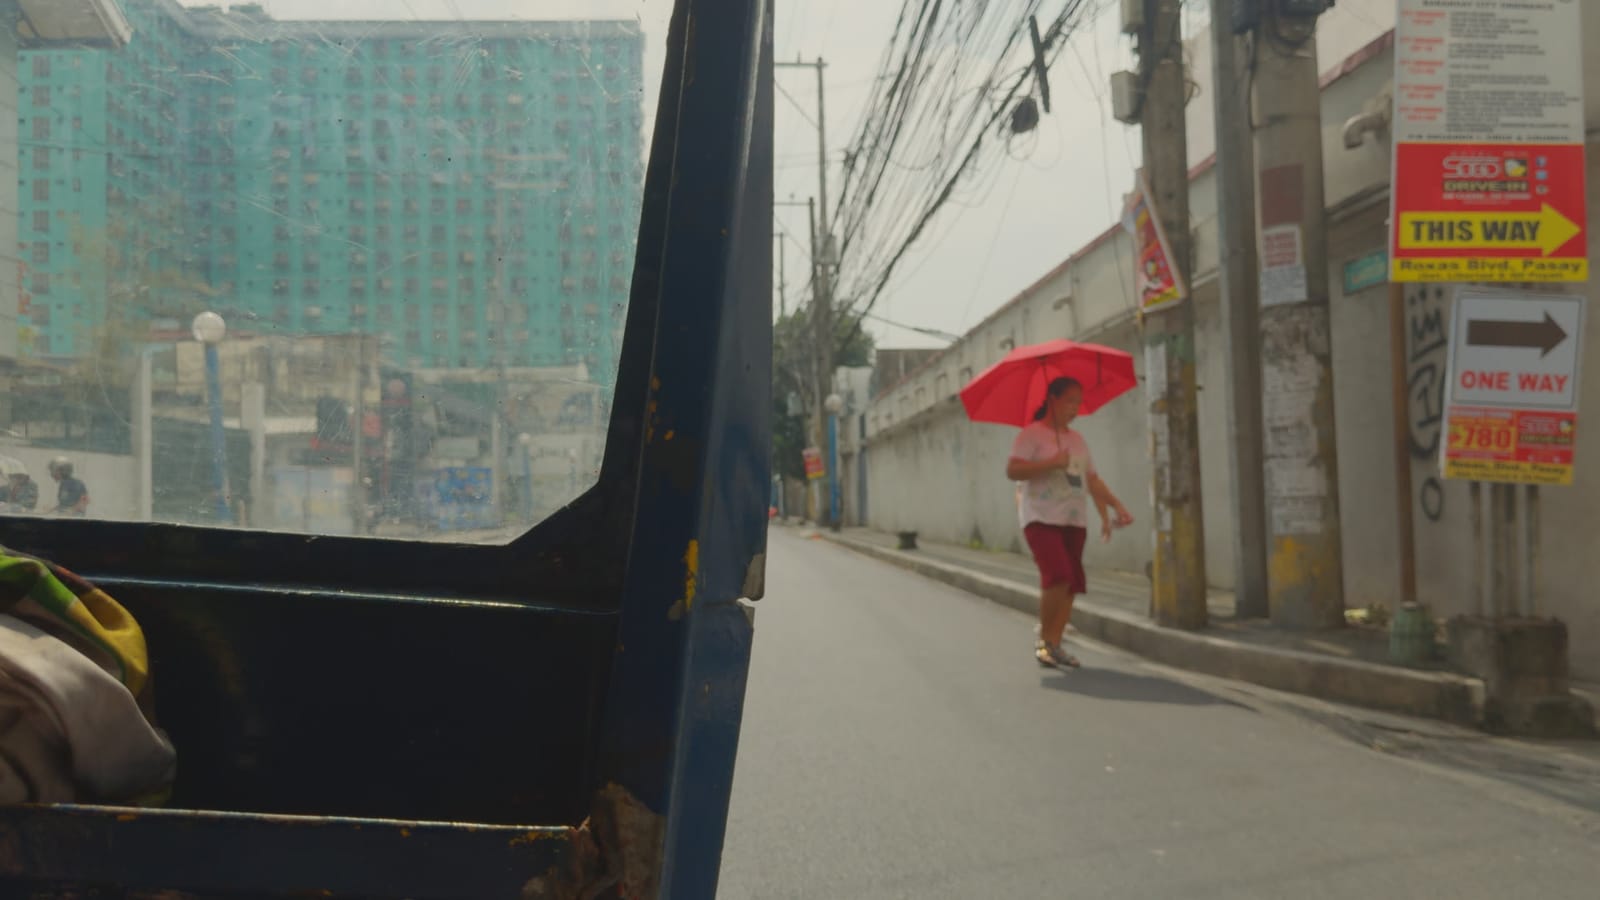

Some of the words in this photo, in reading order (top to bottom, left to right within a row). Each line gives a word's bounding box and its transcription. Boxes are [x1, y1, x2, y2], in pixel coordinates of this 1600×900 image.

[1410, 220, 1474, 242] THIS
[1481, 220, 1540, 242] WAY
[1522, 260, 1581, 273] Pasay
[1460, 370, 1510, 391] ONE
[1517, 373, 1568, 394] WAY
